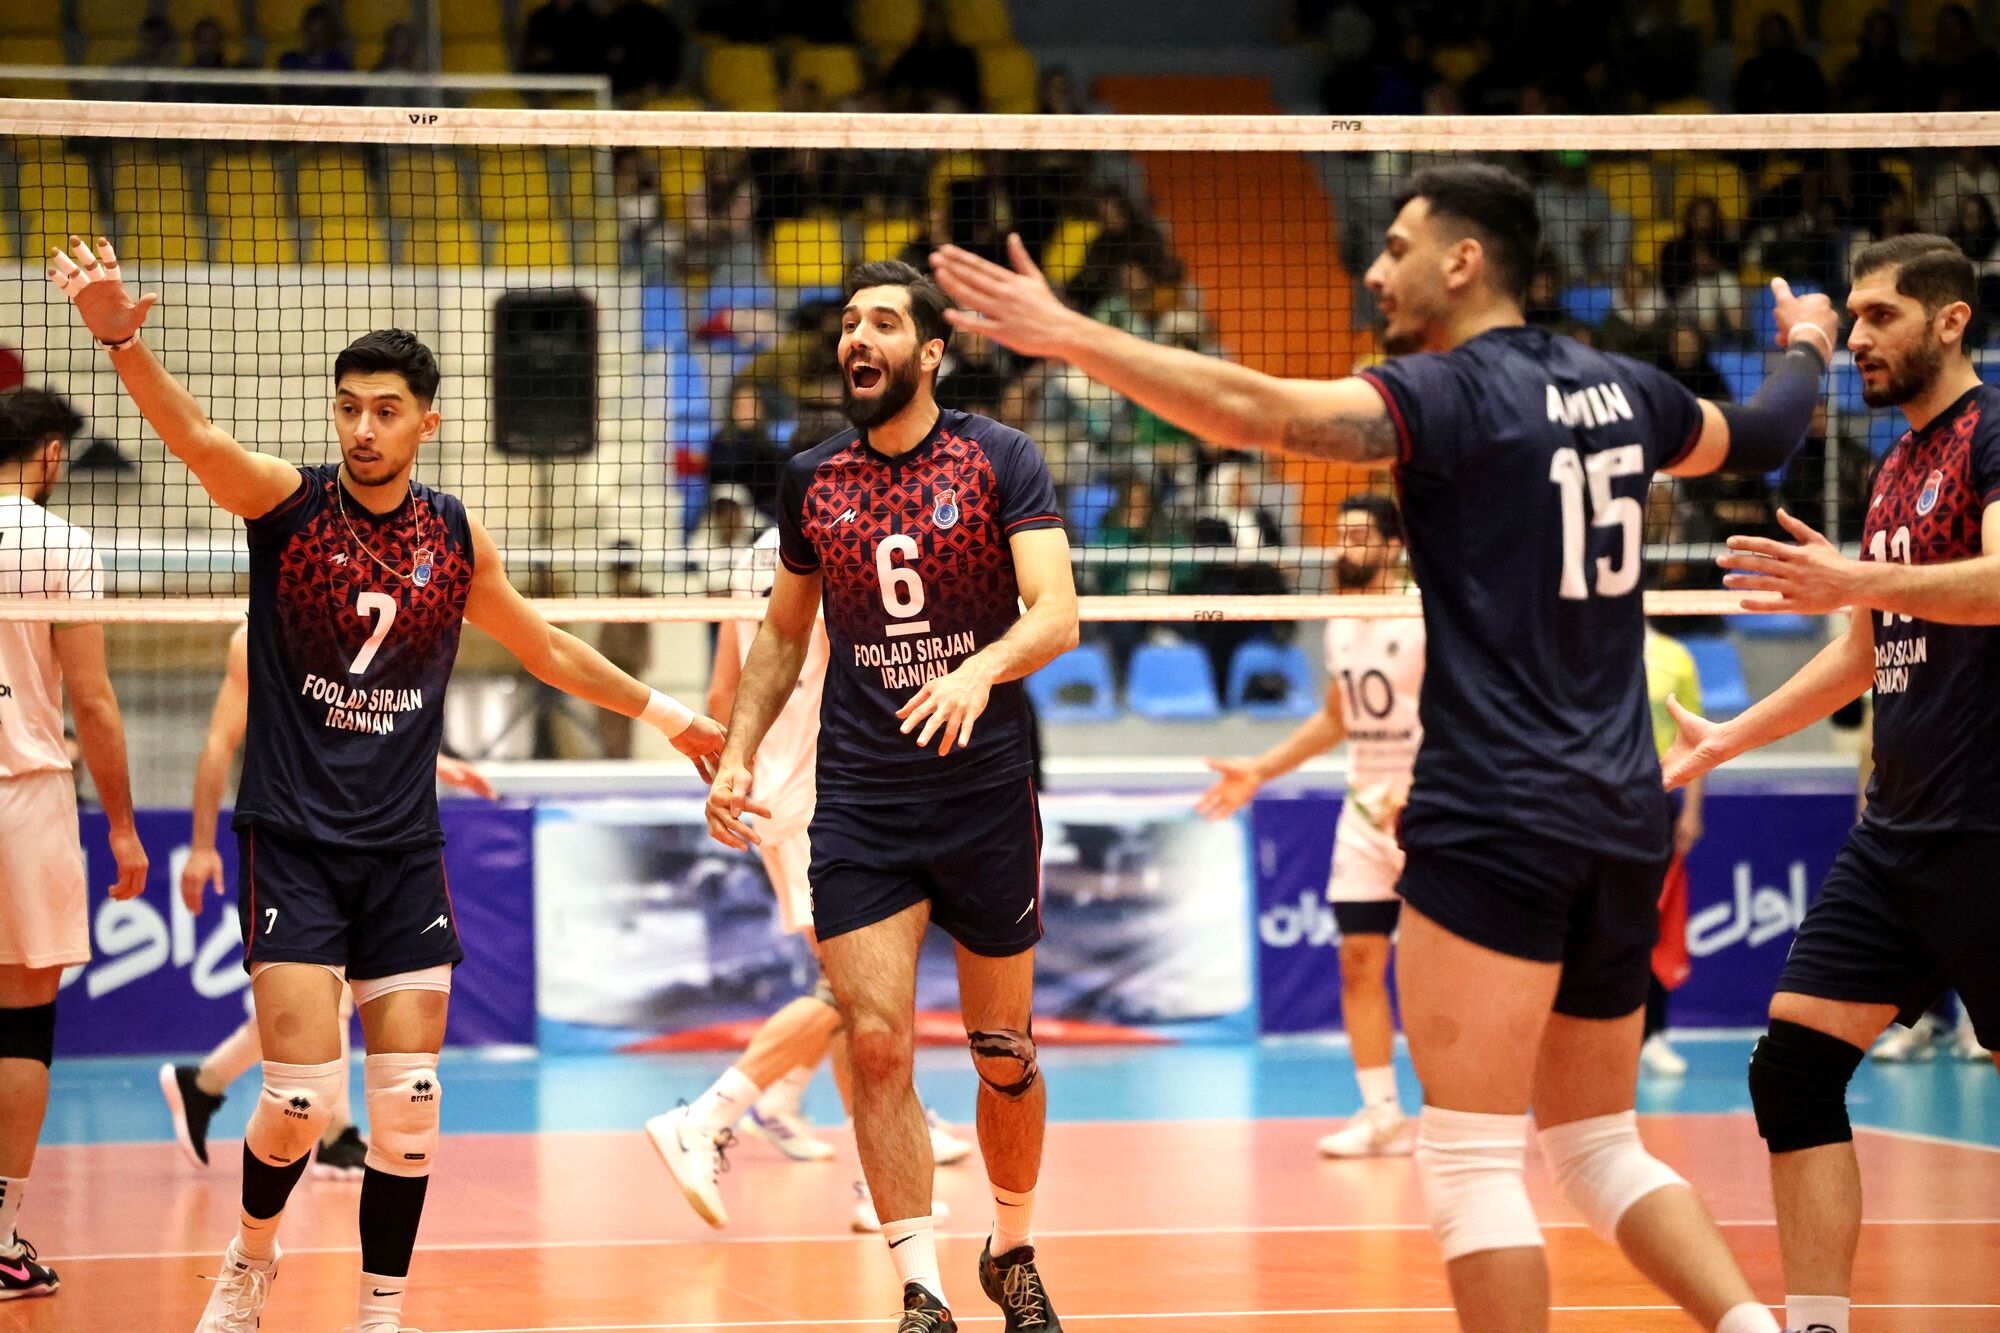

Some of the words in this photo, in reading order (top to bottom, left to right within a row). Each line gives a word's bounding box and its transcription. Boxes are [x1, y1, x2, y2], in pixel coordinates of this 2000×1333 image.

[1549, 444, 1645, 600] 15
[875, 533, 926, 619] 6
[348, 591, 398, 675] 7
[854, 641, 913, 667] FOOLAD
[916, 630, 976, 664] SIRJAN
[302, 673, 367, 709] FOOLAD
[368, 688, 423, 713] SIRJAN
[1341, 668, 1395, 720] 10
[325, 706, 394, 736] IRANIAN
[264, 907, 278, 935] 7
